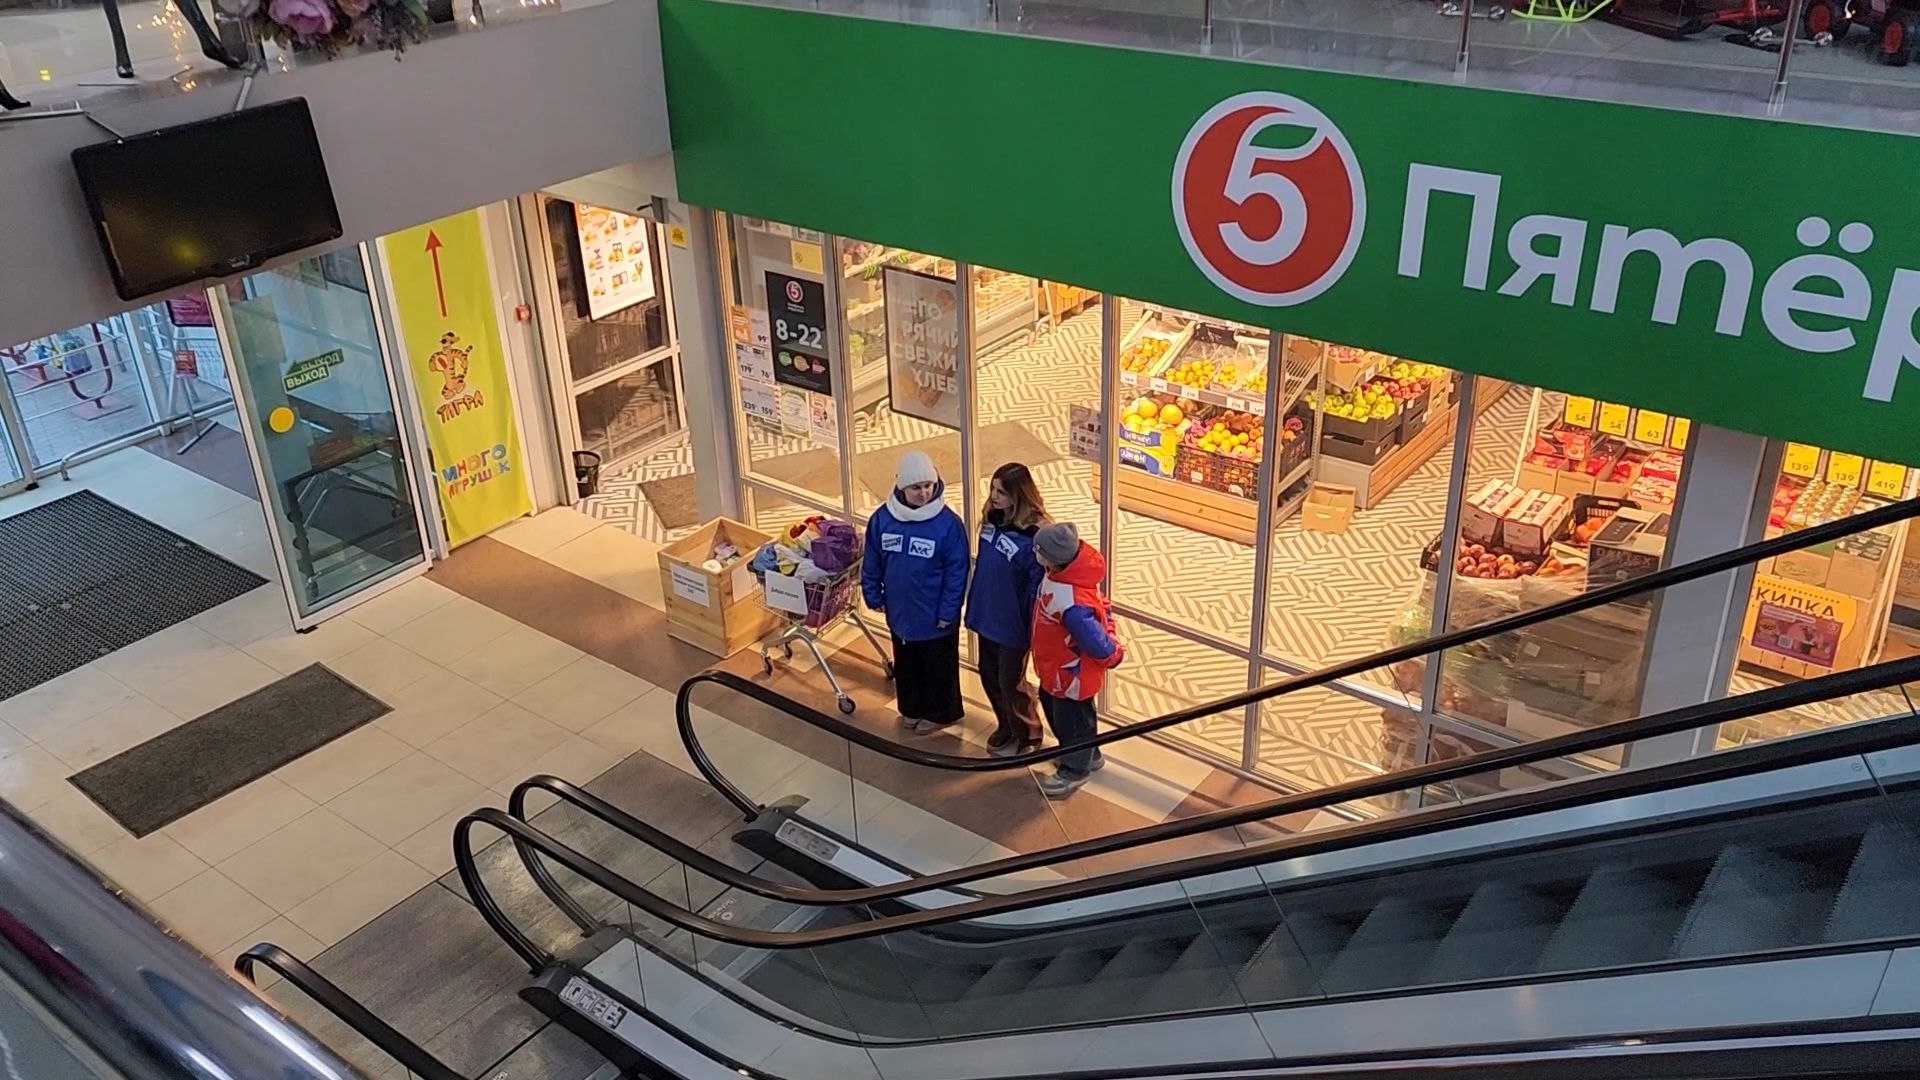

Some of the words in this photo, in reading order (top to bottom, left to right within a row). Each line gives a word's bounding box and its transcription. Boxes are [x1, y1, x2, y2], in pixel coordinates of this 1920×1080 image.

[775, 319, 823, 350] 8-22
[892, 342, 958, 372] СВЕЖИ
[286, 366, 328, 389] ВЫХОД
[436, 390, 484, 424] ТИГРА
[442, 443, 507, 482] МНОГО
[446, 460, 511, 499] ИГРУШК
